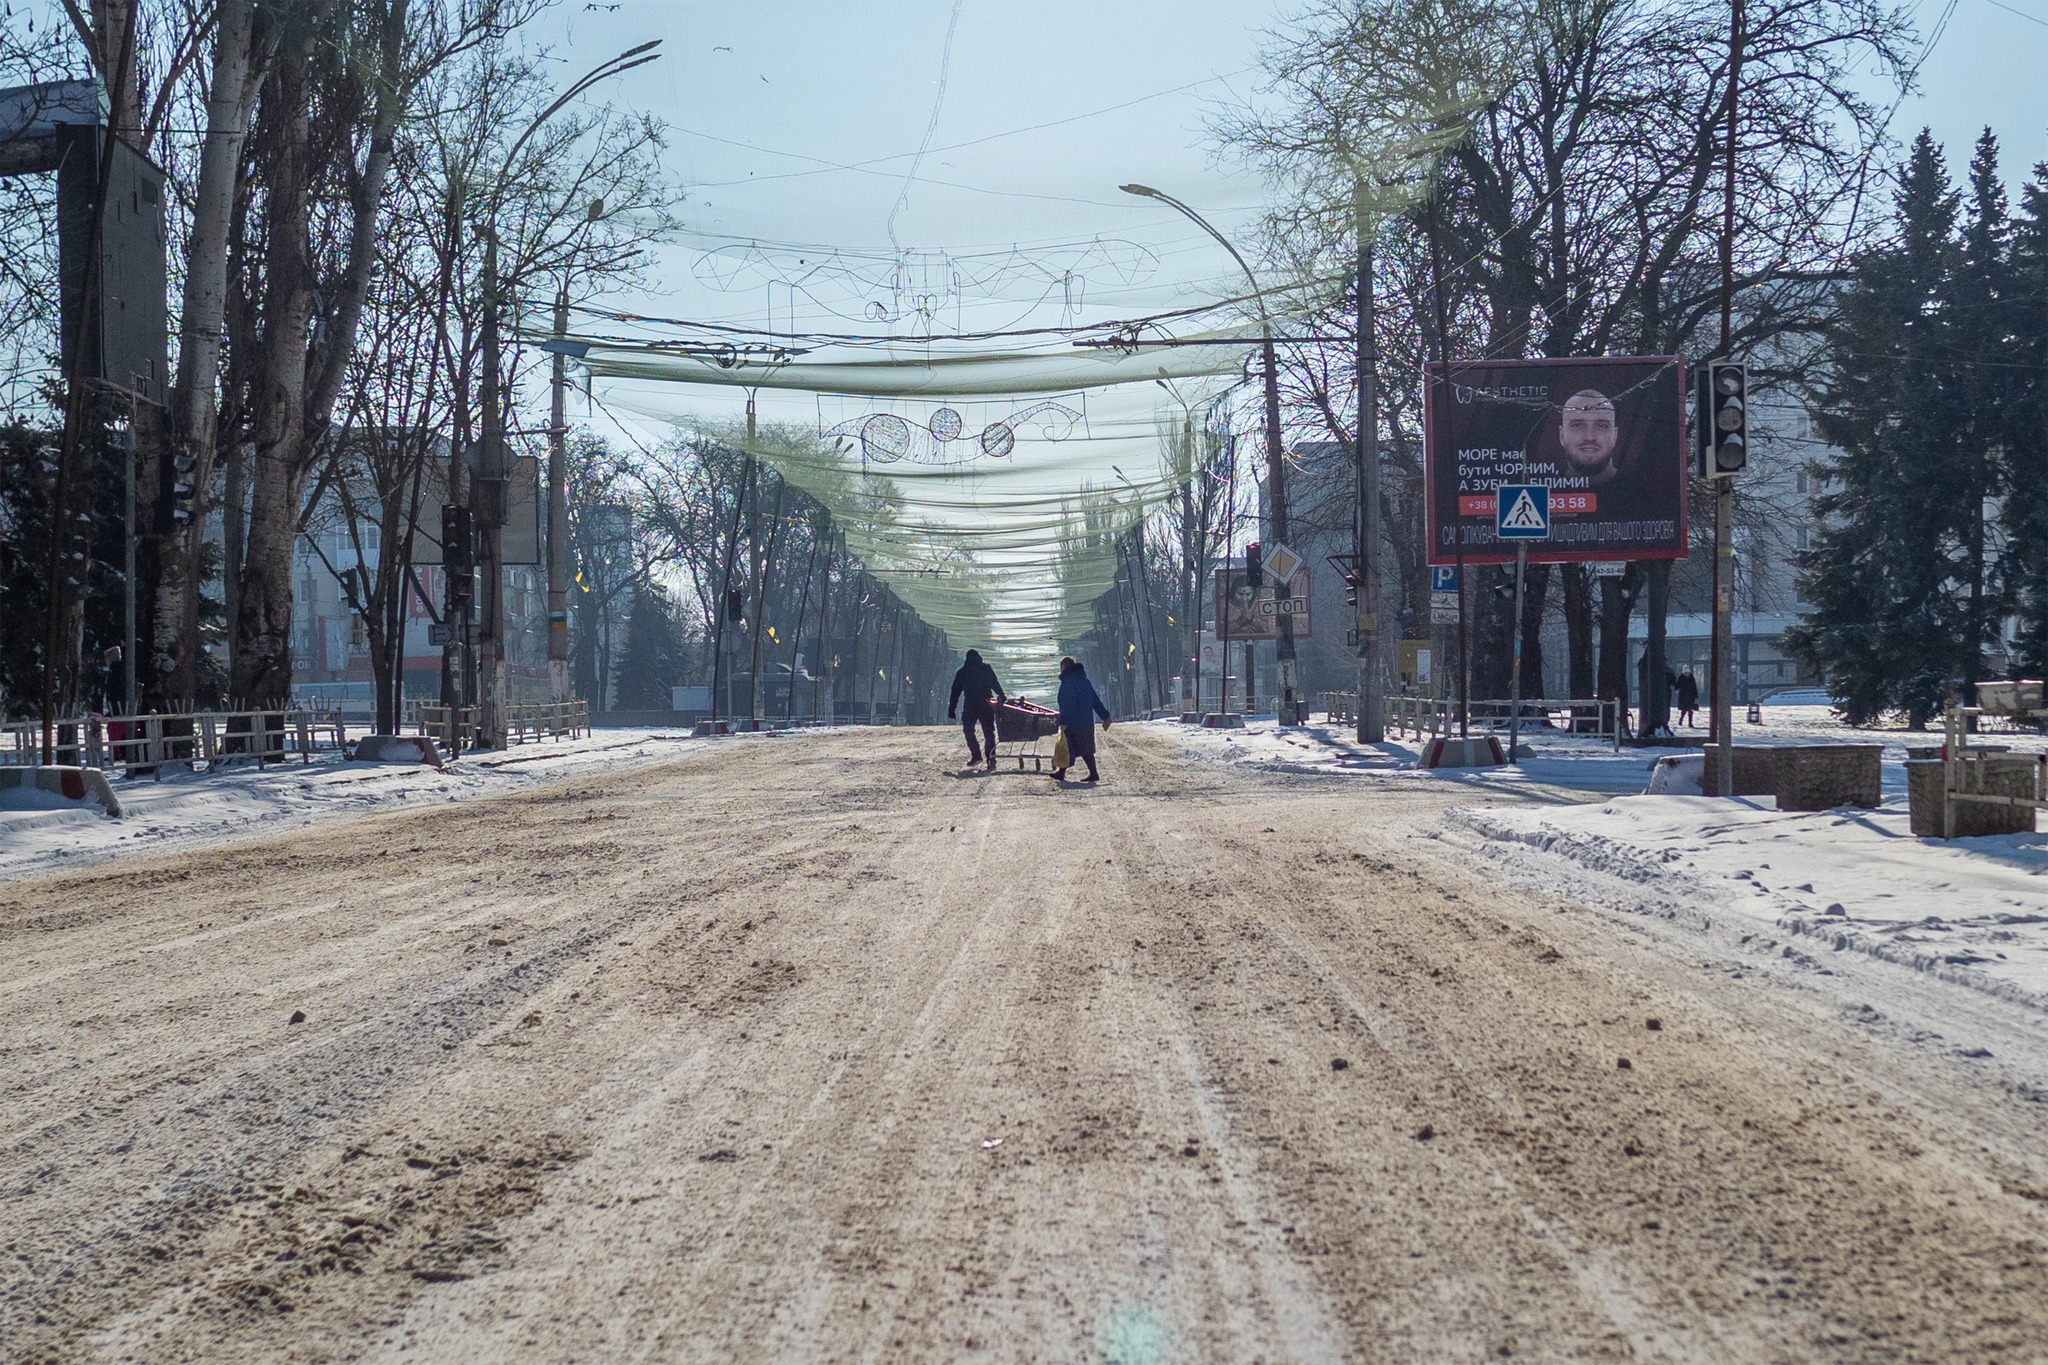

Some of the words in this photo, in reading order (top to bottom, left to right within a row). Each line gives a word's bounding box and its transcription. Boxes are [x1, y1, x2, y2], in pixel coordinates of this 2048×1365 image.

[1458, 448, 1497, 460] МОРЕ
[1458, 464, 1491, 478] бути
[1495, 462, 1559, 475] ЧОРНИМ,
[1459, 480, 1468, 491] А
[1472, 479, 1508, 490] ЗУБИ
[1530, 477, 1589, 488] БІЛИМИ!
[1468, 501, 1487, 510] +38
[1568, 497, 1586, 508] 58
[1437, 566, 1454, 587] P
[1262, 600, 1303, 614] СТОП
